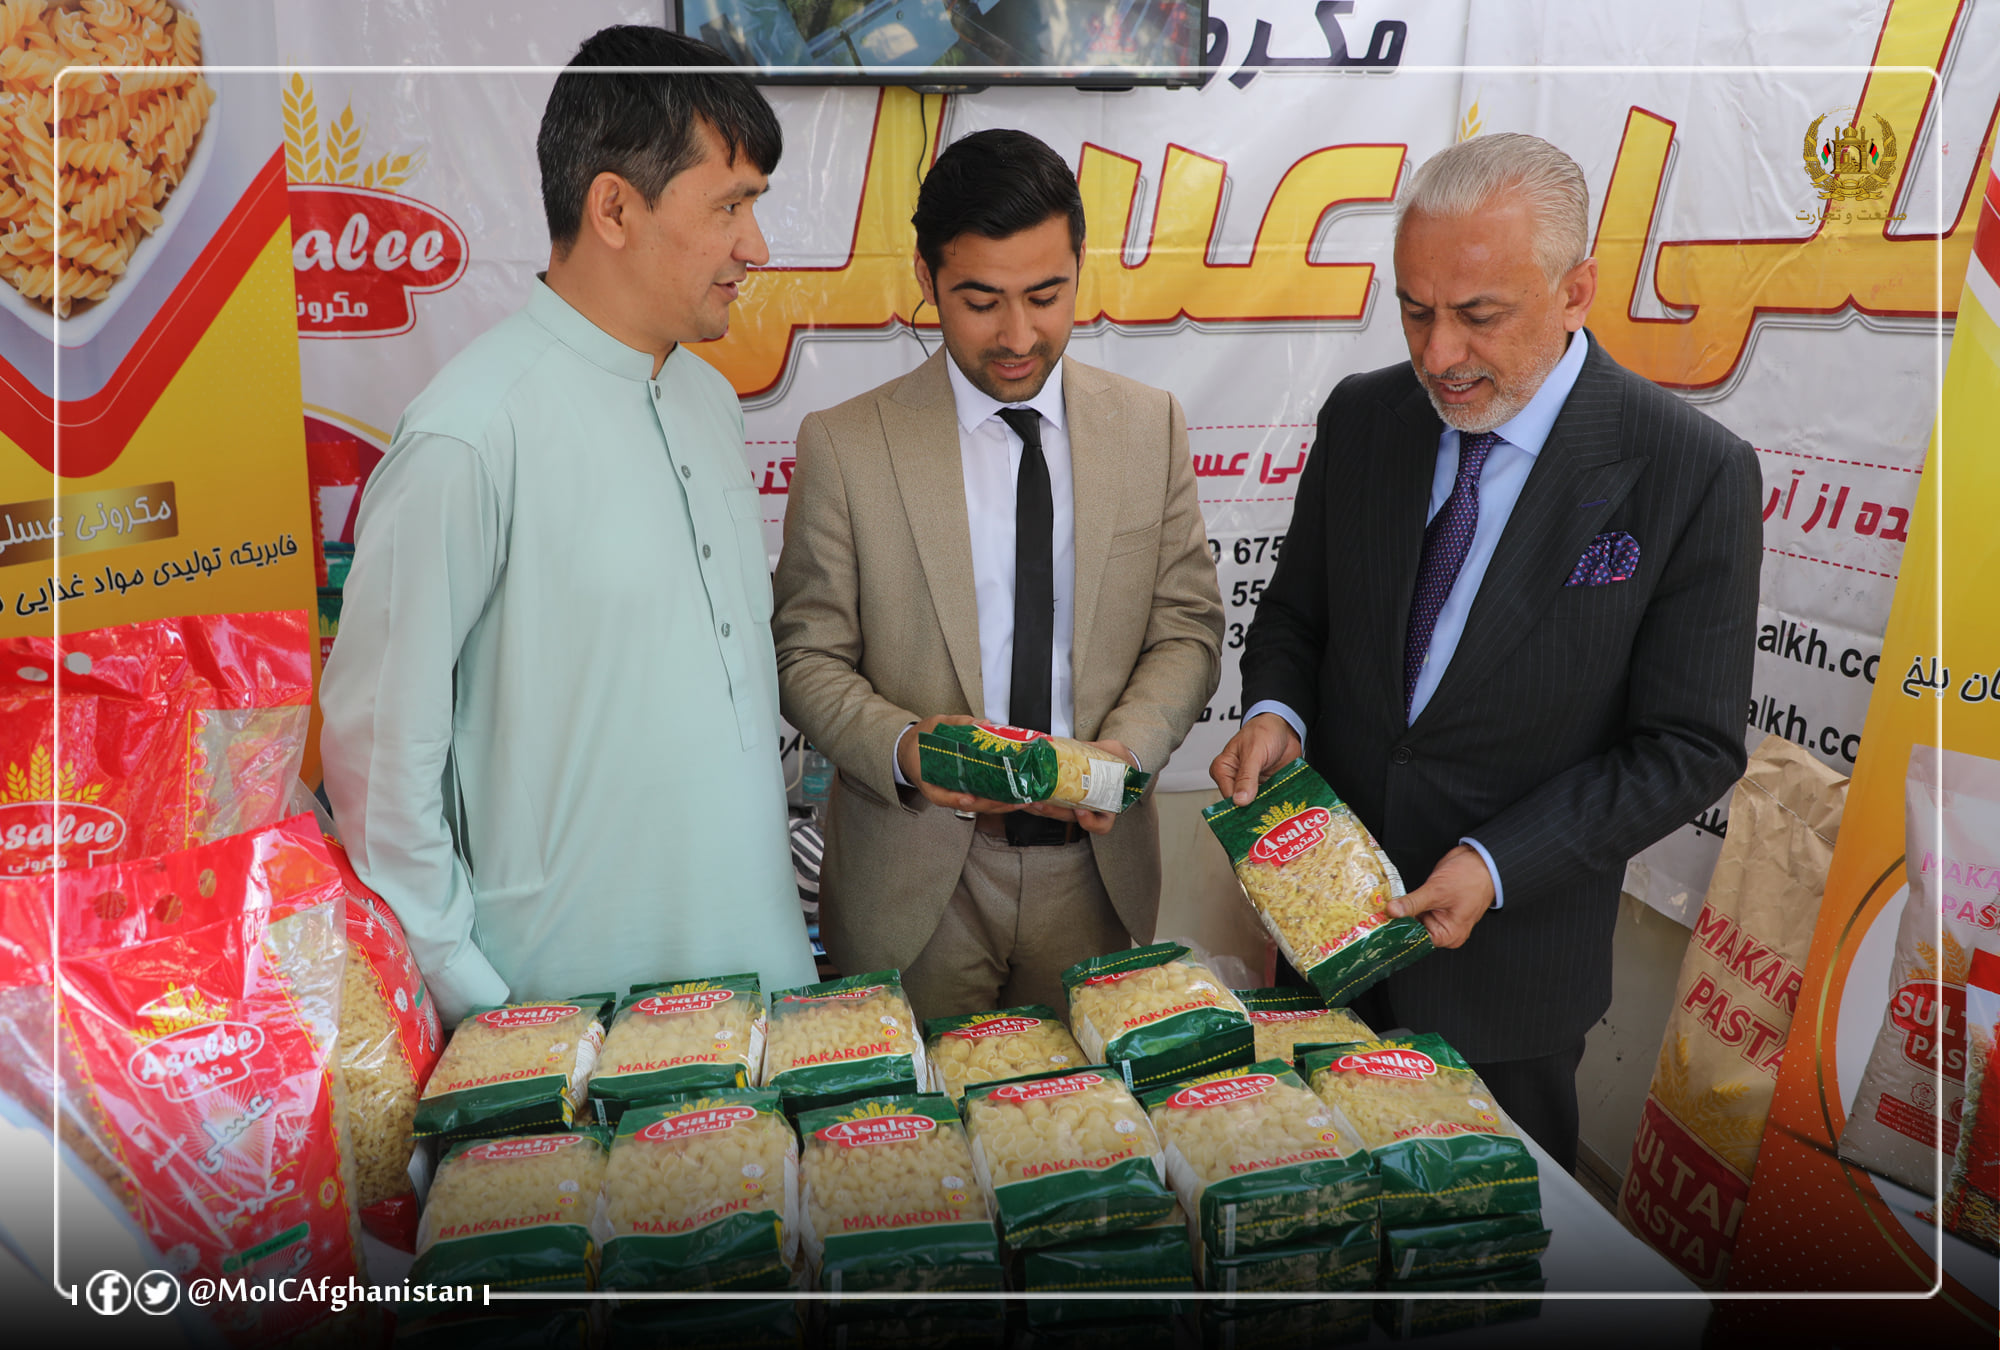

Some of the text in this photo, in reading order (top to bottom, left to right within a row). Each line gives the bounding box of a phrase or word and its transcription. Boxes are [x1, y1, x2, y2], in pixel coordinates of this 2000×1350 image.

[75, 495, 173, 542] مکرونی
[1800, 482, 1851, 534] از
[152, 546, 223, 587] تولیدی
[229, 534, 299, 568] فابریکه
[14, 573, 86, 617] غذایی
[93, 565, 146, 596] مواد
[1902, 656, 1950, 698] بلخ
[0, 813, 116, 851] salee
[1262, 809, 1329, 856] Asalee
[1690, 900, 1805, 1018] MAKAR
[1122, 998, 1218, 1030] MAKARONI
[139, 1029, 256, 1082] Asalee
[615, 1053, 719, 1075] MAKARONI
[791, 1041, 893, 1068] MAKARONI
[1350, 1051, 1432, 1073] Asalee
[447, 1066, 549, 1092] MAKARONI
[1180, 1075, 1271, 1105] Asalee
[837, 1118, 930, 1137] Asalee
[1392, 1121, 1500, 1140] MAKARONI
[1022, 1147, 1136, 1178] MAKARONI
[1229, 1146, 1340, 1175] MAKARONI
[438, 1210, 562, 1239] MAKARONI
[632, 1198, 751, 1234] MAKARONI
[842, 1208, 964, 1231] MAKARONI
[1627, 1171, 1706, 1271] PASTA
